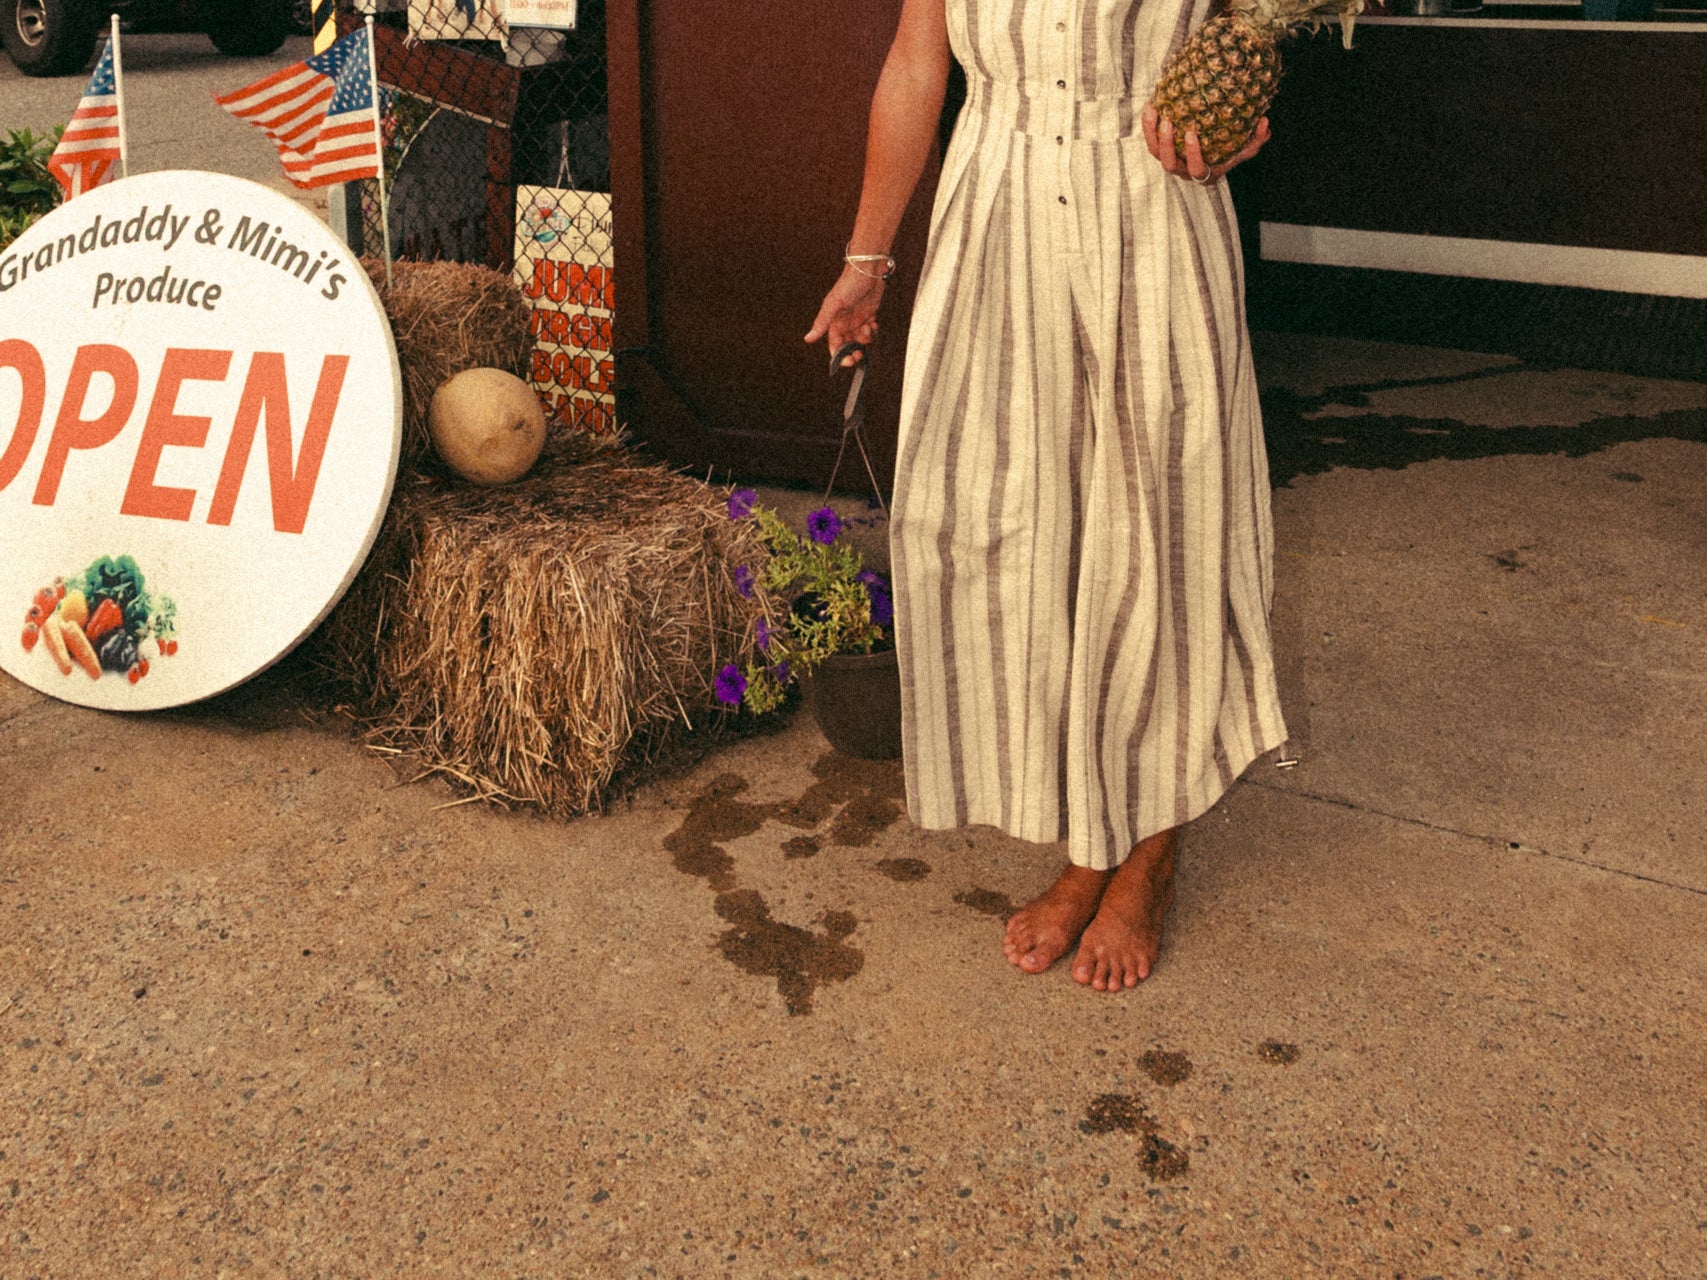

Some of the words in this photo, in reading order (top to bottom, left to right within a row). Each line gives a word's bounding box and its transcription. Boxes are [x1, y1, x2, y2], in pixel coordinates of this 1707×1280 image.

[0, 204, 191, 293] Grandaddy
[194, 208, 224, 246] &
[227, 215, 347, 301] Mimi's
[93, 265, 222, 311] Produce
